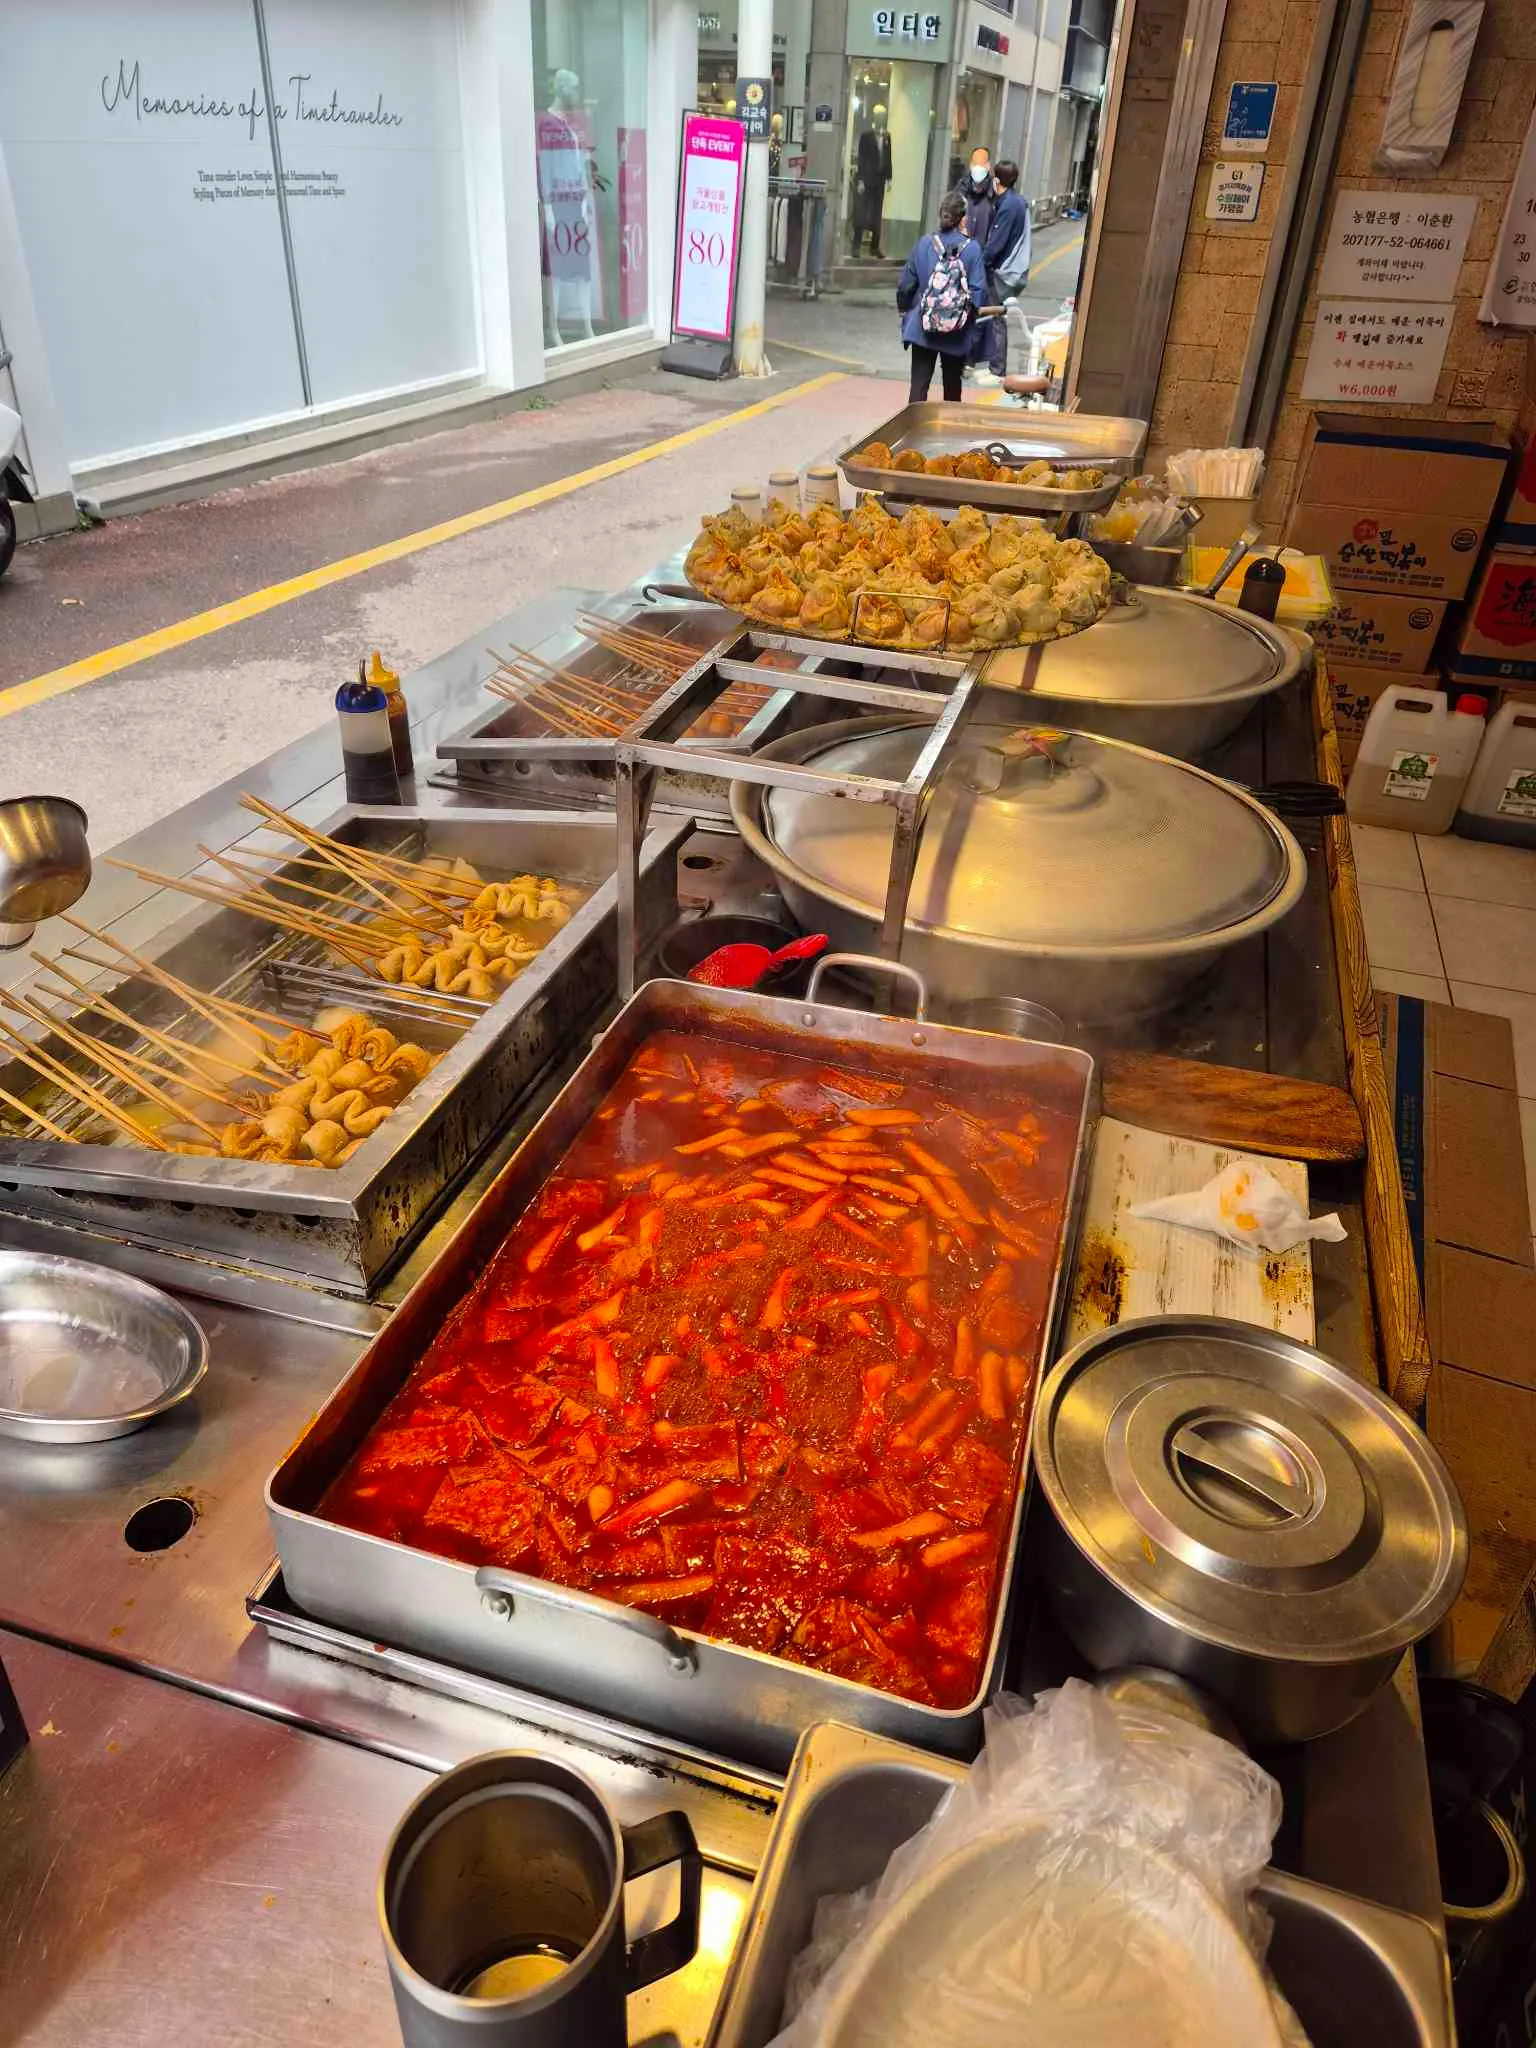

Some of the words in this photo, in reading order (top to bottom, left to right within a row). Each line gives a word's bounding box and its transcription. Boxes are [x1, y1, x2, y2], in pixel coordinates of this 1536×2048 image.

[876, 11, 941, 38] 인디안
[101, 59, 233, 121] Memories
[238, 88, 264, 140] of
[273, 102, 287, 120] a
[289, 74, 403, 126] Timetraveler
[708, 138, 736, 154] EVENT
[1352, 210, 1401, 226] 농협은행
[1342, 234, 1451, 251] 207177-52-064661
[1513, 233, 1526, 245] 23
[688, 228, 725, 268] 80
[1357, 257, 1388, 269] 계좌이체
[1392, 258, 1424, 271] 바랍니다
[1518, 252, 1530, 263] 30
[1349, 313, 1386, 326] 집에서도
[1391, 315, 1411, 327] 매운
[1416, 316, 1445, 328] 어묵이
[1386, 333, 1424, 345] 즐기세요
